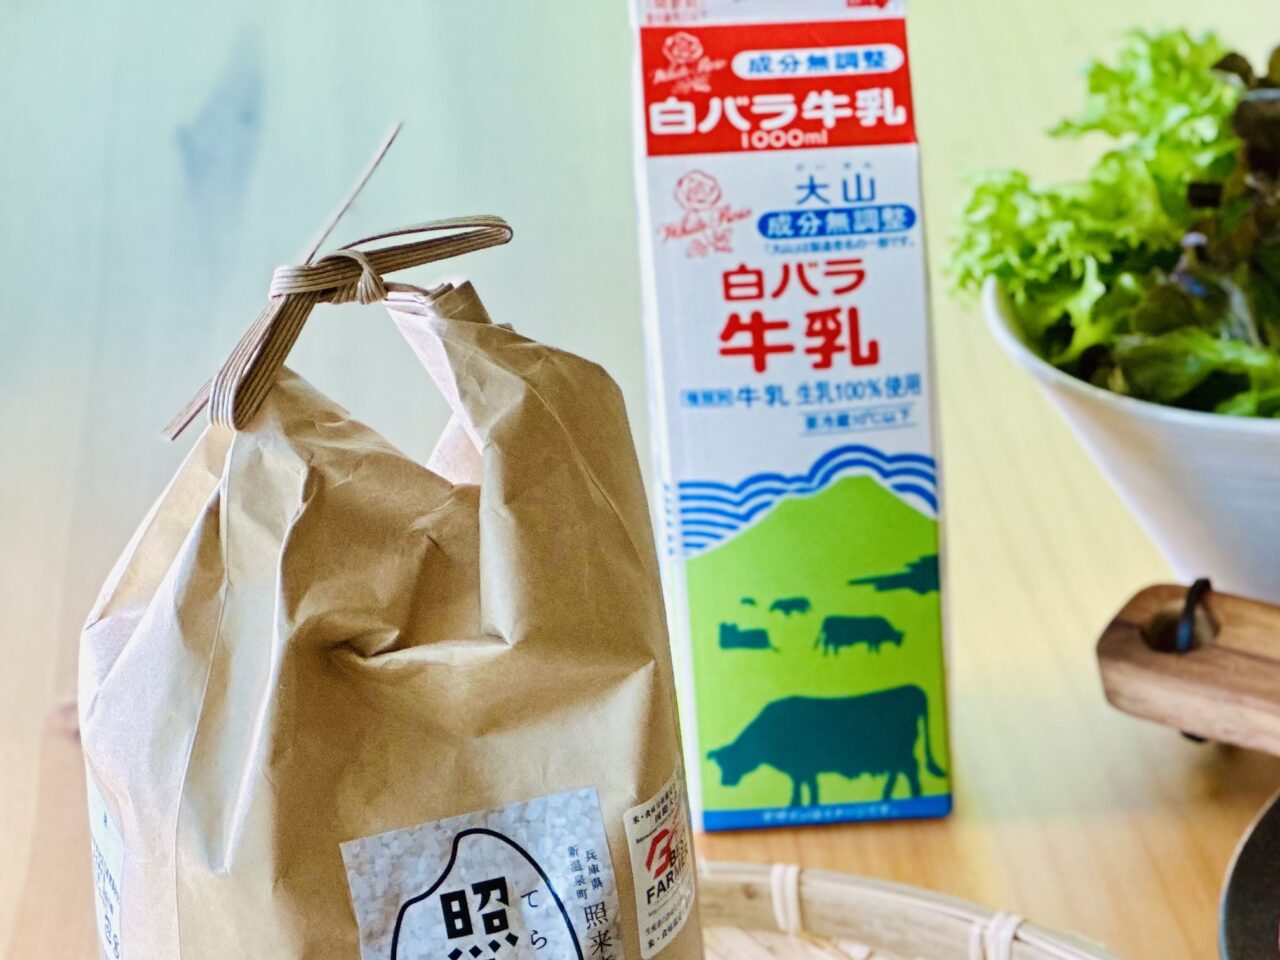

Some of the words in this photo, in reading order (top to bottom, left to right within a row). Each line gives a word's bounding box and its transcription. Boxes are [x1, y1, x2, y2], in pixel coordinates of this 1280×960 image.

[748, 49, 887, 74] 成分無調整
[648, 87, 907, 135] 白バラ牛乳
[741, 129, 829, 149] 1000ml
[795, 172, 877, 205] 大山
[767, 206, 907, 236] 成分無調整
[722, 258, 866, 302] 白バラ
[718, 306, 880, 374] 牛乳
[796, 373, 922, 405] 生乳100%使用
[567, 844, 588, 900] 新温泉町
[584, 849, 604, 890] 兵庫県
